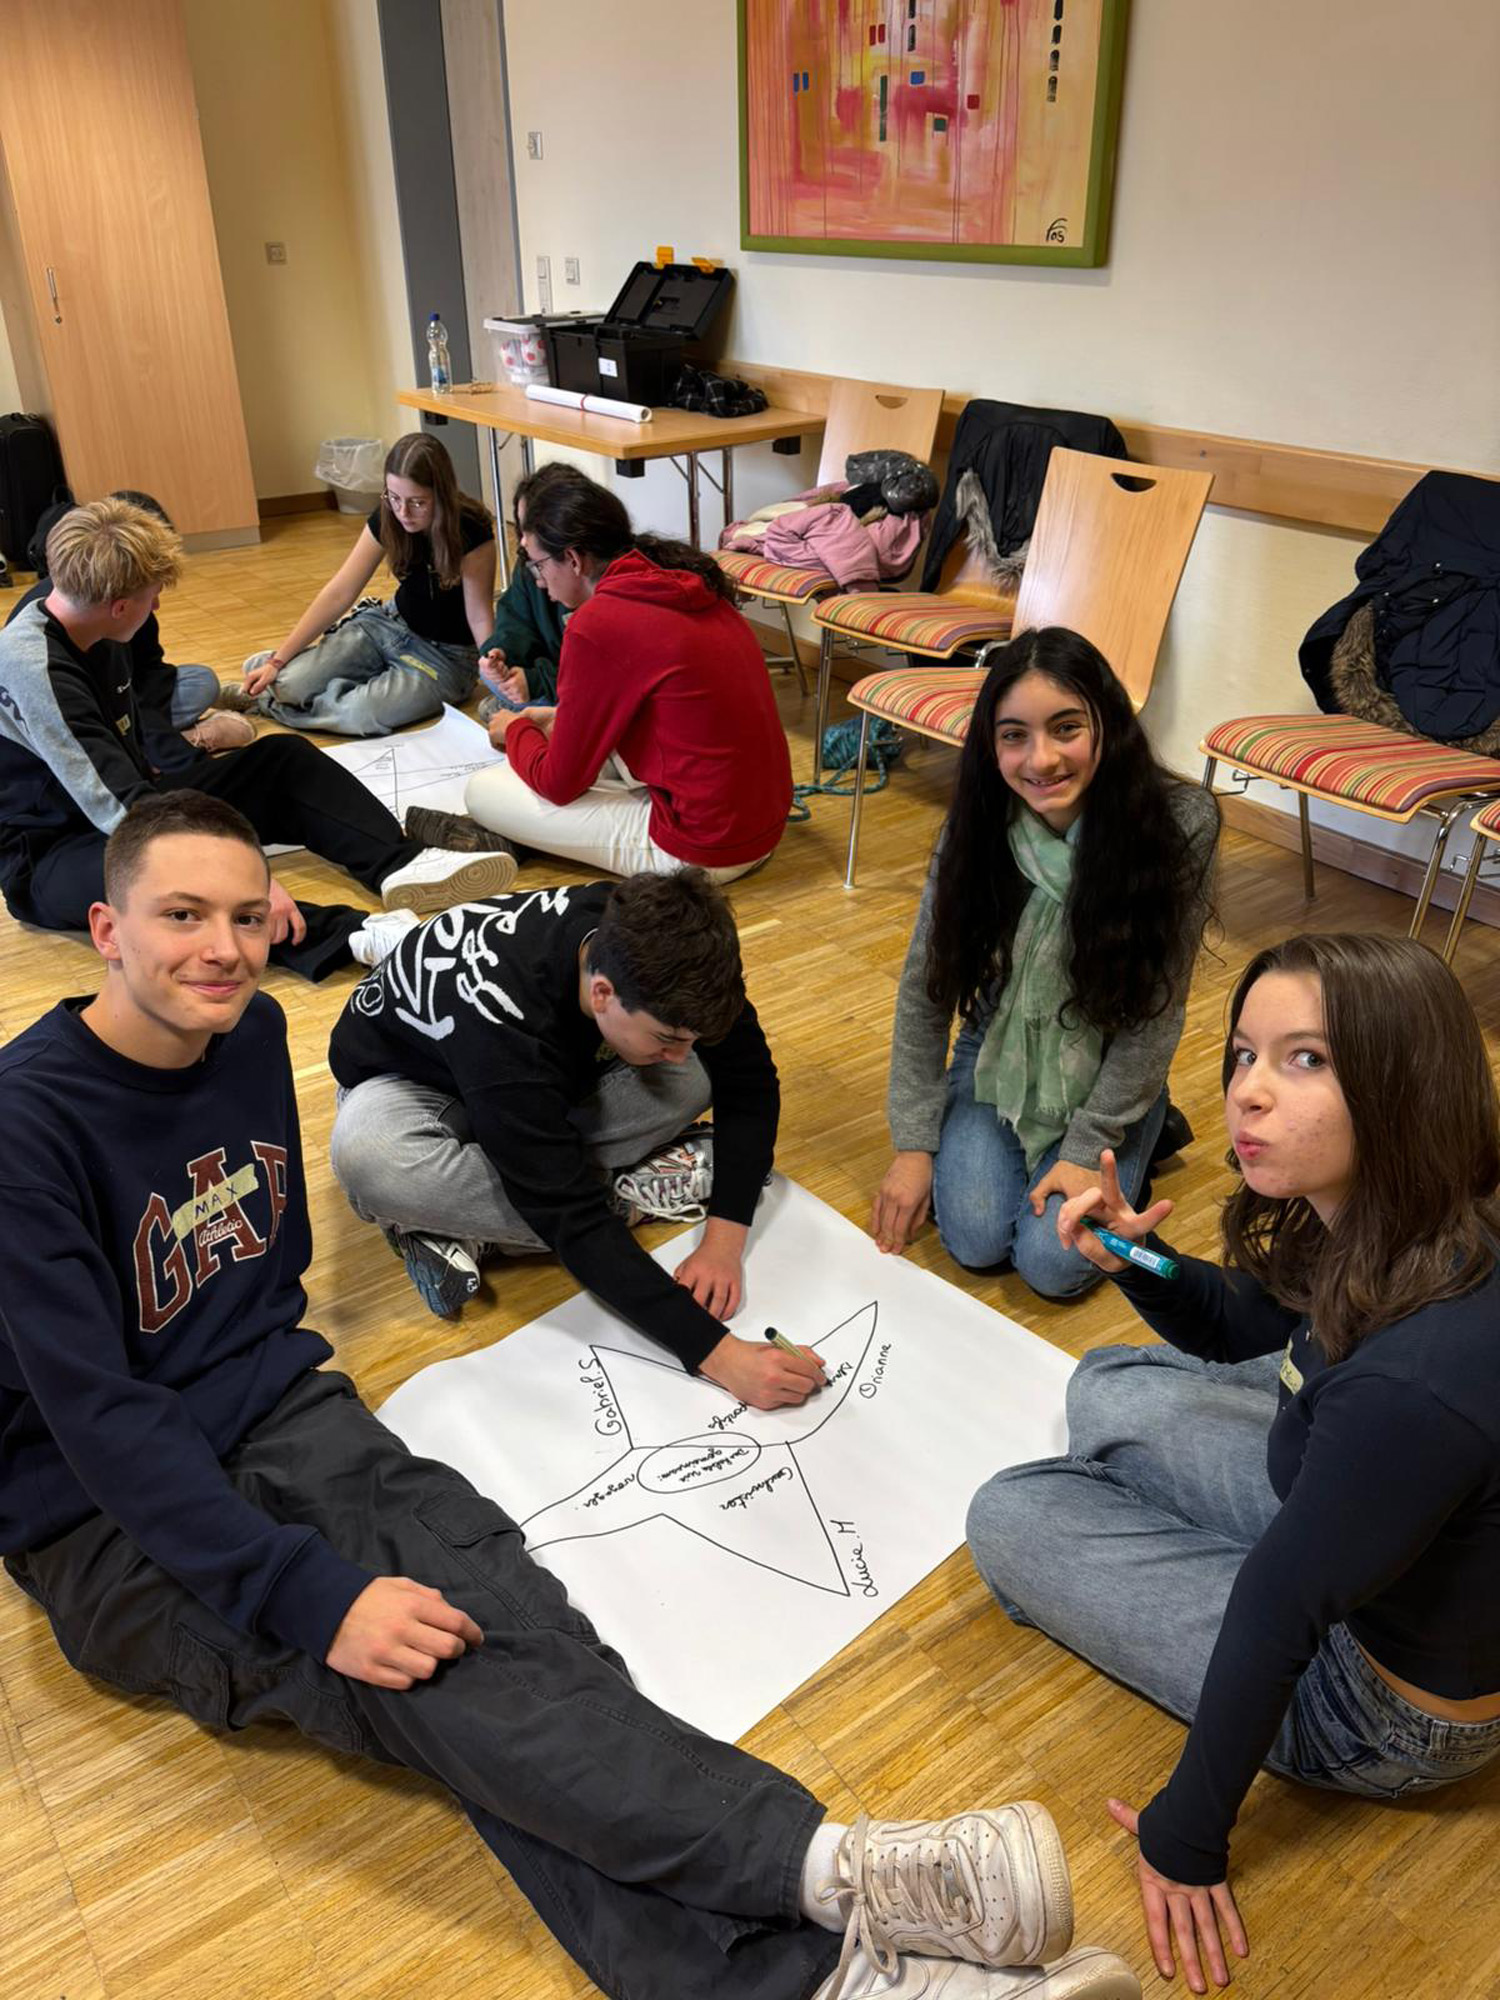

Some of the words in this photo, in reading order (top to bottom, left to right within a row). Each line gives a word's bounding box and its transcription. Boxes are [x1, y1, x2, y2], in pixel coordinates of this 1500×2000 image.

[195, 1182, 239, 1220] MAX
[133, 1140, 287, 1333] GAP
[859, 1343, 892, 1399] Orianne
